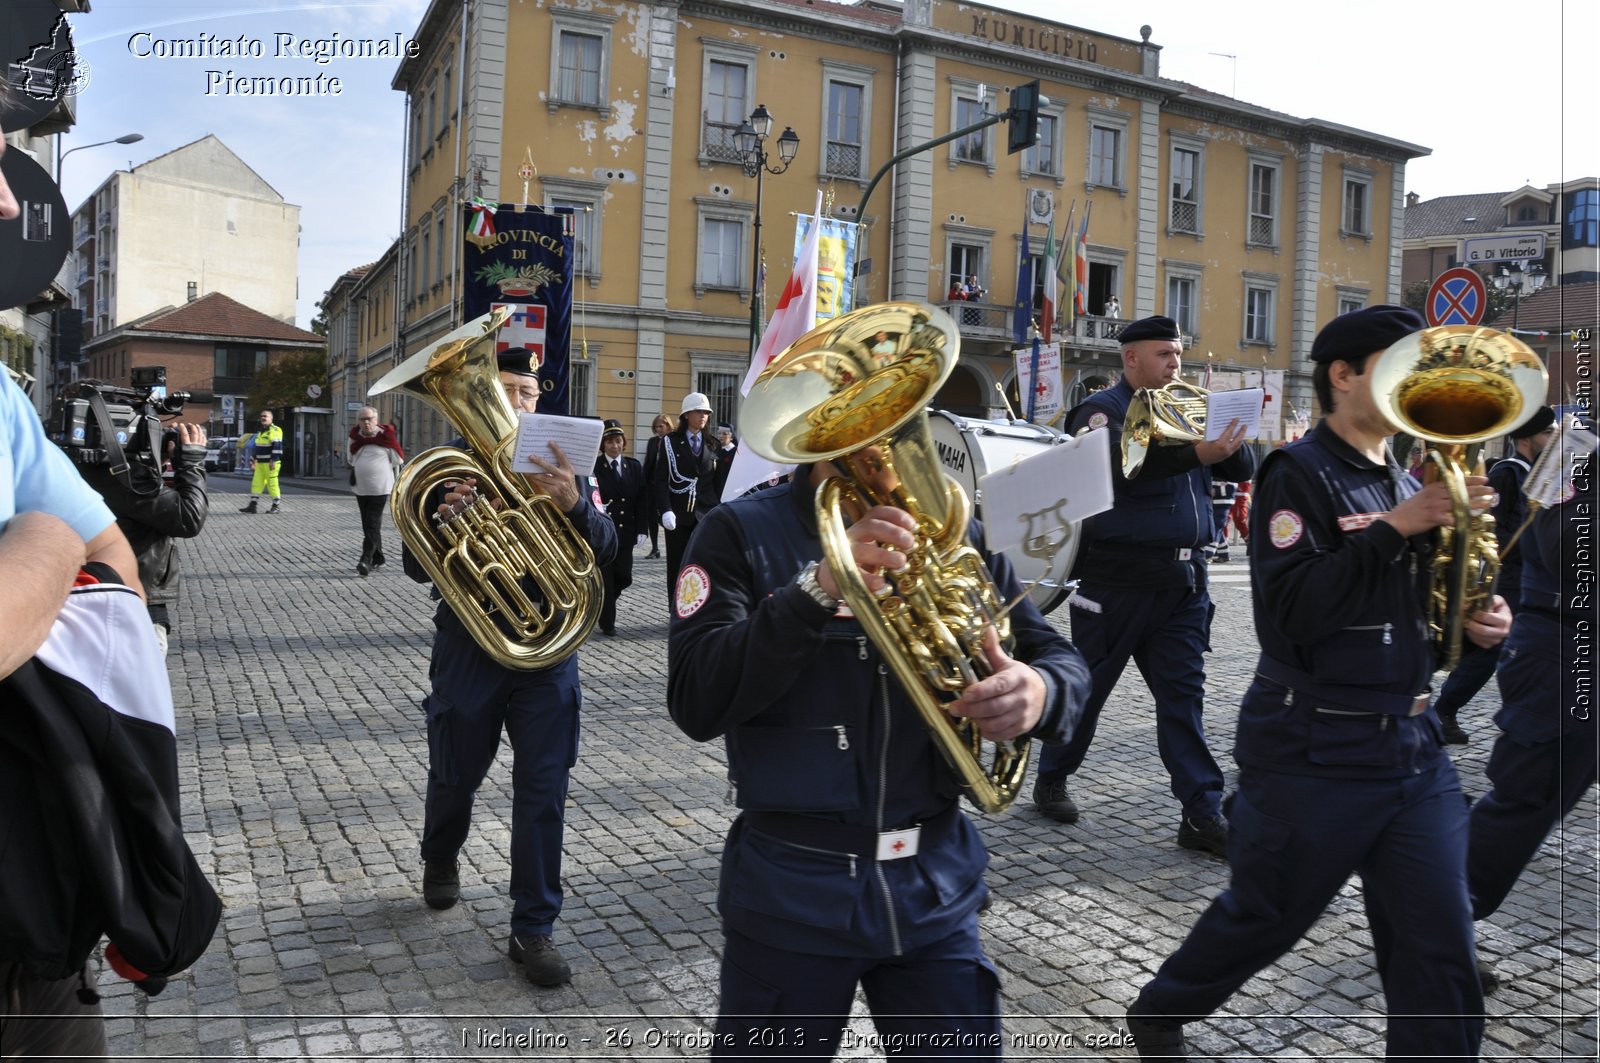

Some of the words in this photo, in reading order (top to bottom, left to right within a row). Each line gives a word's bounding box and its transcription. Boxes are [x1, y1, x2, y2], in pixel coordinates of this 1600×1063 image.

[971, 14, 1098, 63] MUNICIPIO
[480, 229, 564, 258] OVINCIA
[512, 249, 527, 260] DI
[1470, 250, 1480, 260] G.
[1485, 249, 1495, 259] Di
[1500, 246, 1537, 258] Vittorio
[935, 440, 966, 473] MAHA
